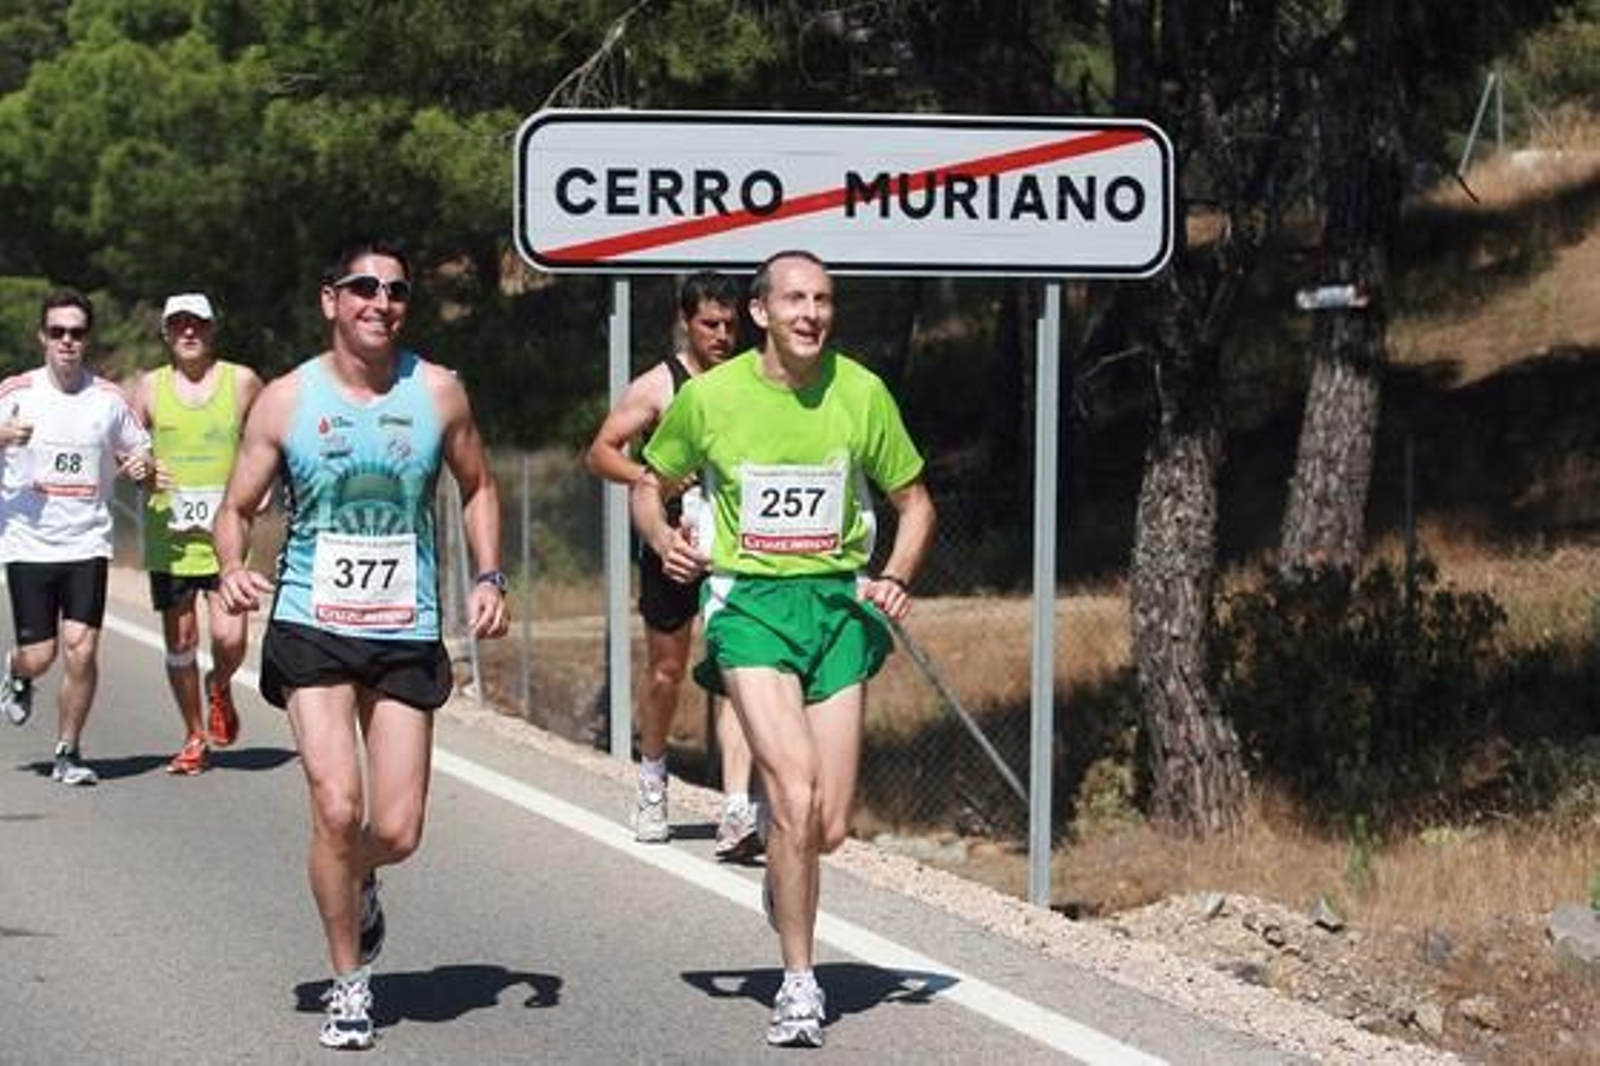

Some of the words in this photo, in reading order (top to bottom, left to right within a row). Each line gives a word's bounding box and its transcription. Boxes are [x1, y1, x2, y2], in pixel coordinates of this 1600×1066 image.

[555, 167, 784, 218] CERRO
[842, 170, 1146, 223] MURIANO
[55, 453, 82, 473] 68
[183, 501, 208, 520] 20
[761, 487, 826, 518] 257
[334, 558, 400, 590] 377
